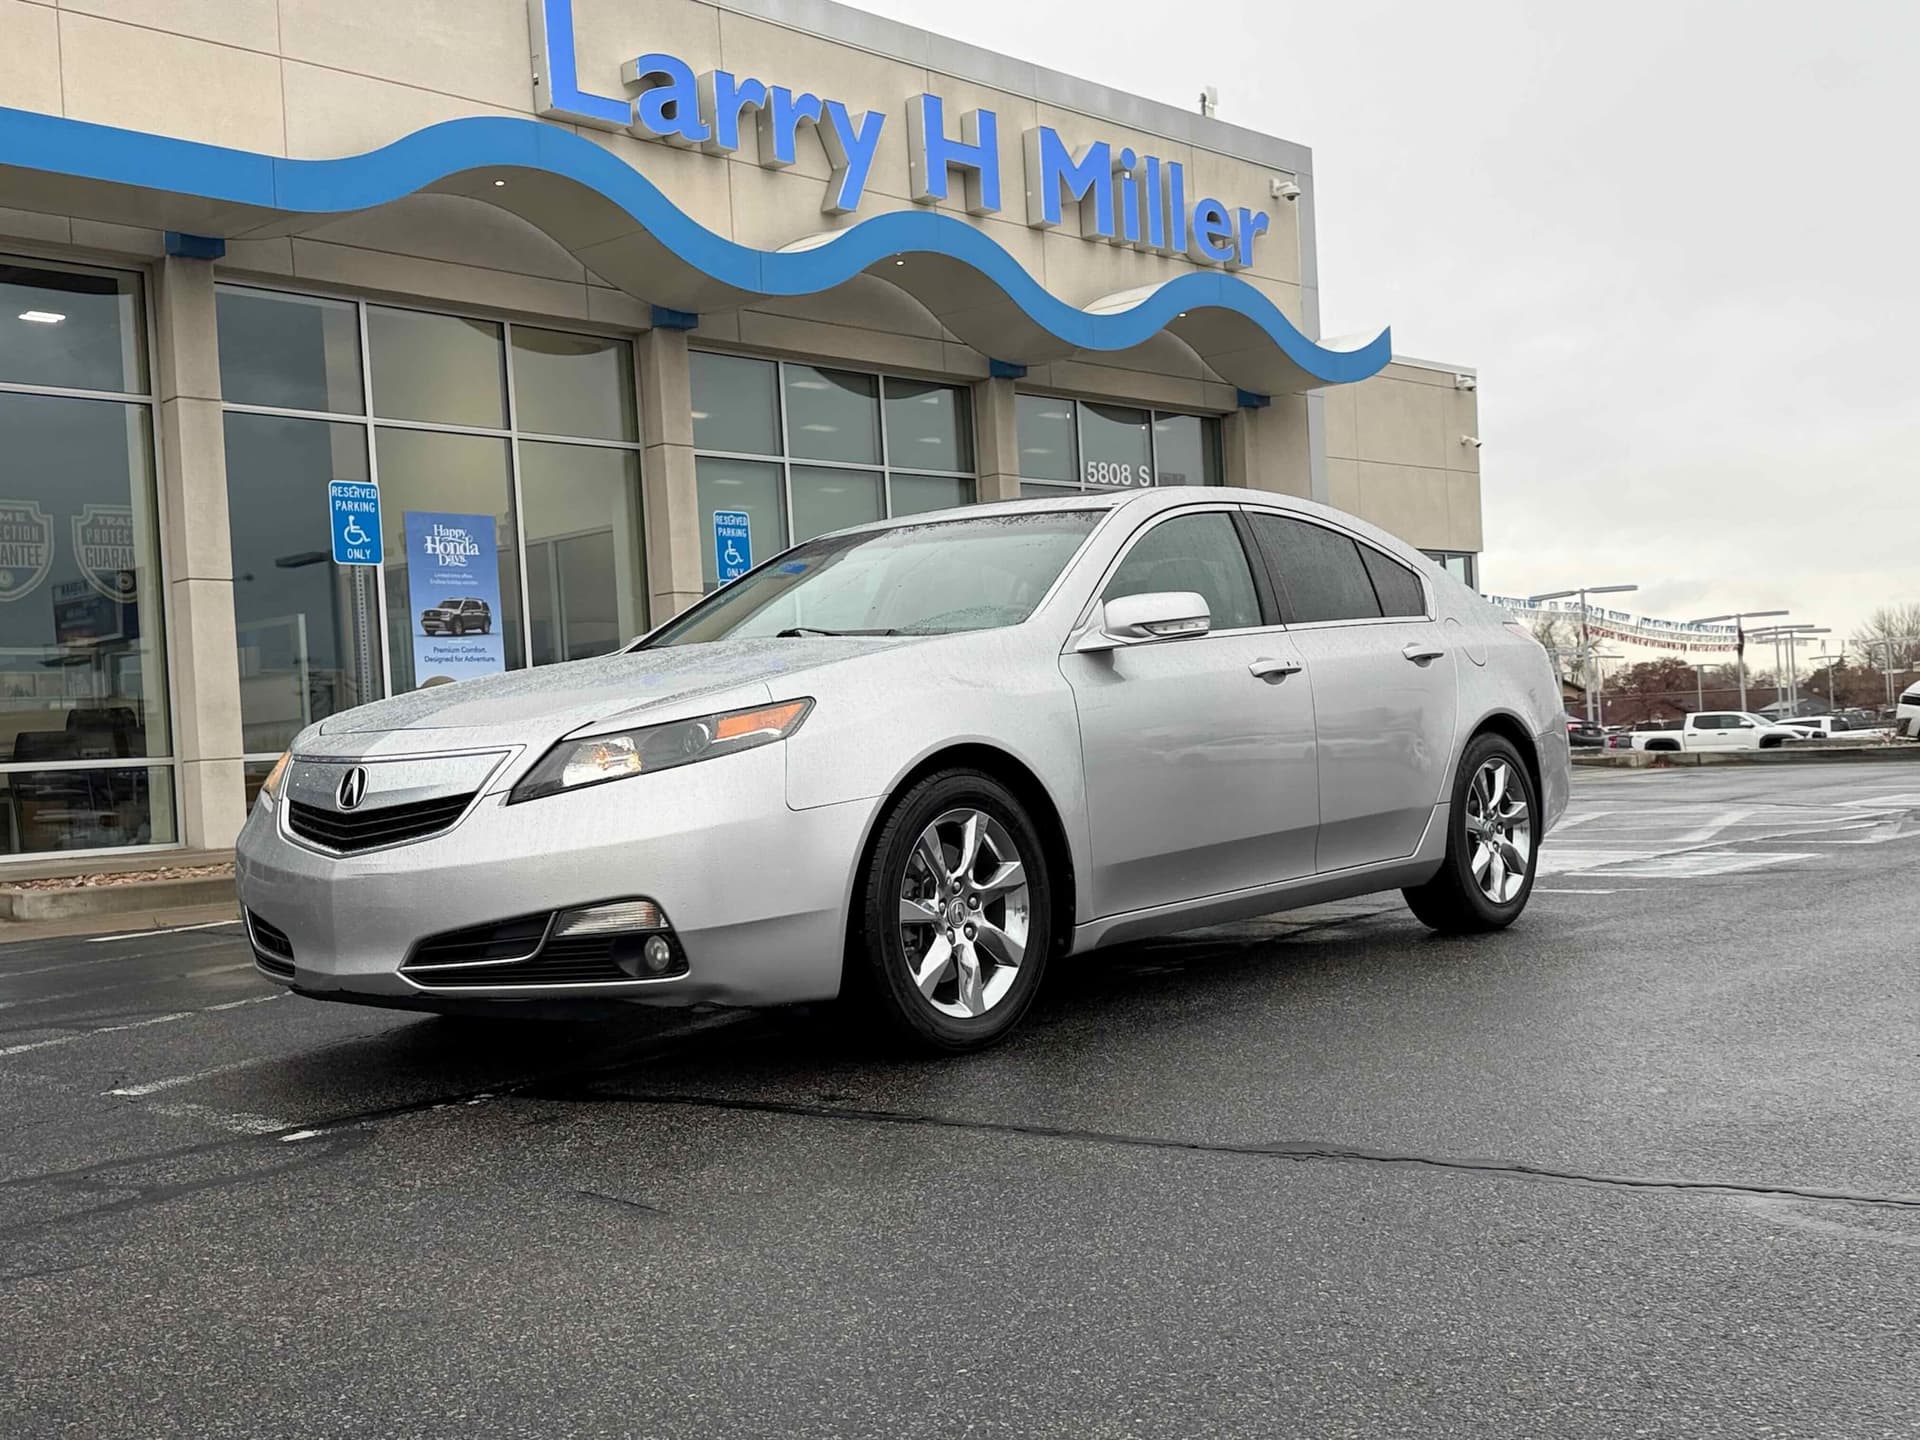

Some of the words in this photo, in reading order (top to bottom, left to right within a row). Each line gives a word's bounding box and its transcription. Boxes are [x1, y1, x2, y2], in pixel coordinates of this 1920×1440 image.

[537, 0, 887, 214] Larry
[912, 93, 1000, 214] H
[1032, 126, 1270, 270] Miller
[1087, 461, 1132, 485] 5808
[1138, 465, 1150, 487] S
[331, 485, 377, 499] RESERVED
[335, 500, 375, 513] PARKING
[716, 514, 748, 526] RESERVED
[433, 523, 468, 541] Happy
[717, 527, 747, 538] PARKING
[424, 535, 480, 555] Honda
[347, 548, 371, 560] ONLY
[439, 554, 469, 567] Days
